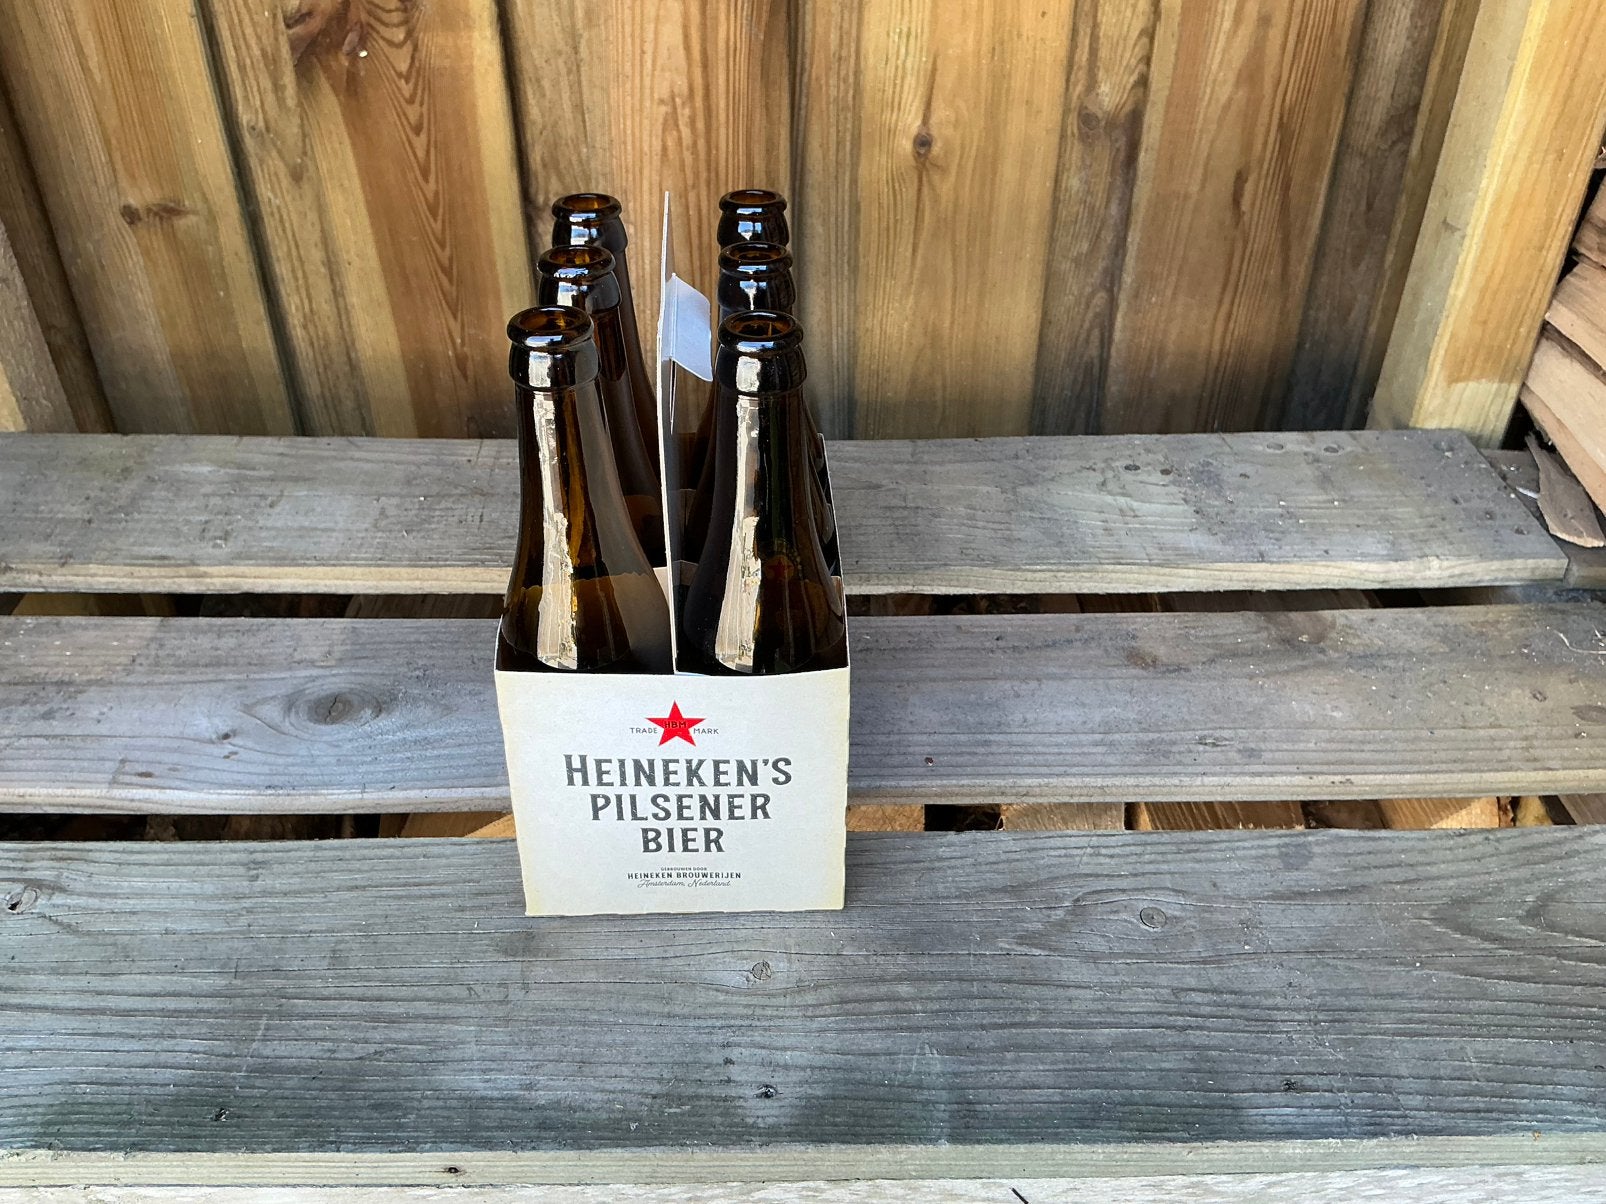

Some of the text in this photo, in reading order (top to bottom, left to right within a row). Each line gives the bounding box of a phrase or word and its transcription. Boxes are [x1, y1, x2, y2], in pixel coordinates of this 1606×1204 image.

[664, 720, 687, 729] HBM
[693, 727, 720, 735] MARK
[563, 754, 792, 787] HEINEKEN'S
[589, 793, 772, 821] PILSENER
[640, 827, 726, 853] BIER
[627, 872, 673, 880] HEINEKEN
